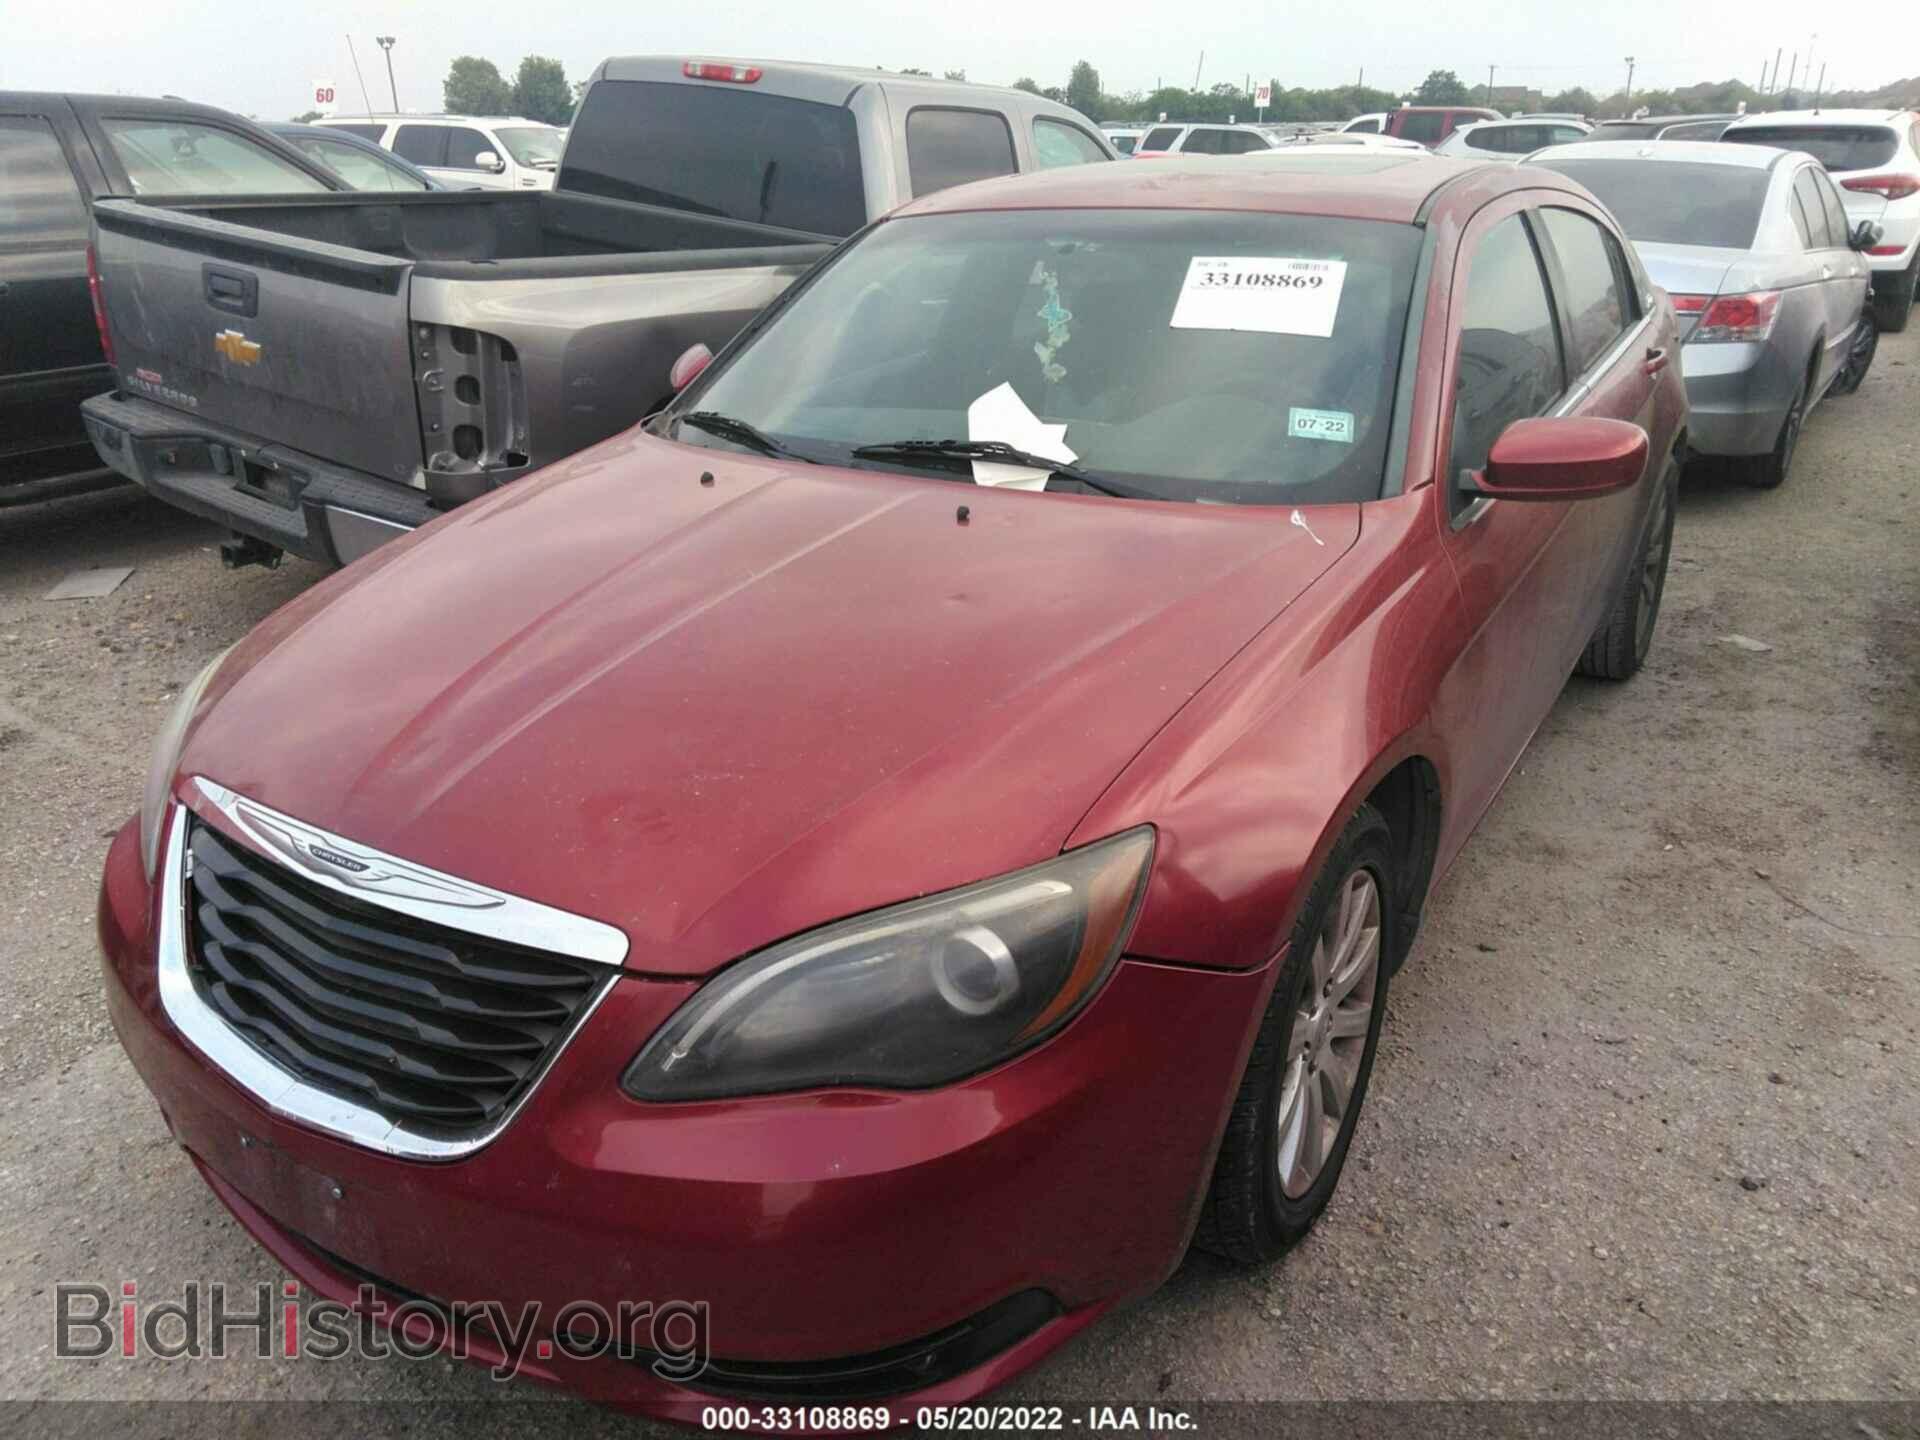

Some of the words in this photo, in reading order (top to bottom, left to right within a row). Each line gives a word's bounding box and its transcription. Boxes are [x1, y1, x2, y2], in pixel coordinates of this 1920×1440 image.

[316, 87, 334, 103] 60
[1257, 86, 1269, 99] 70
[1199, 271, 1324, 289] 33108869
